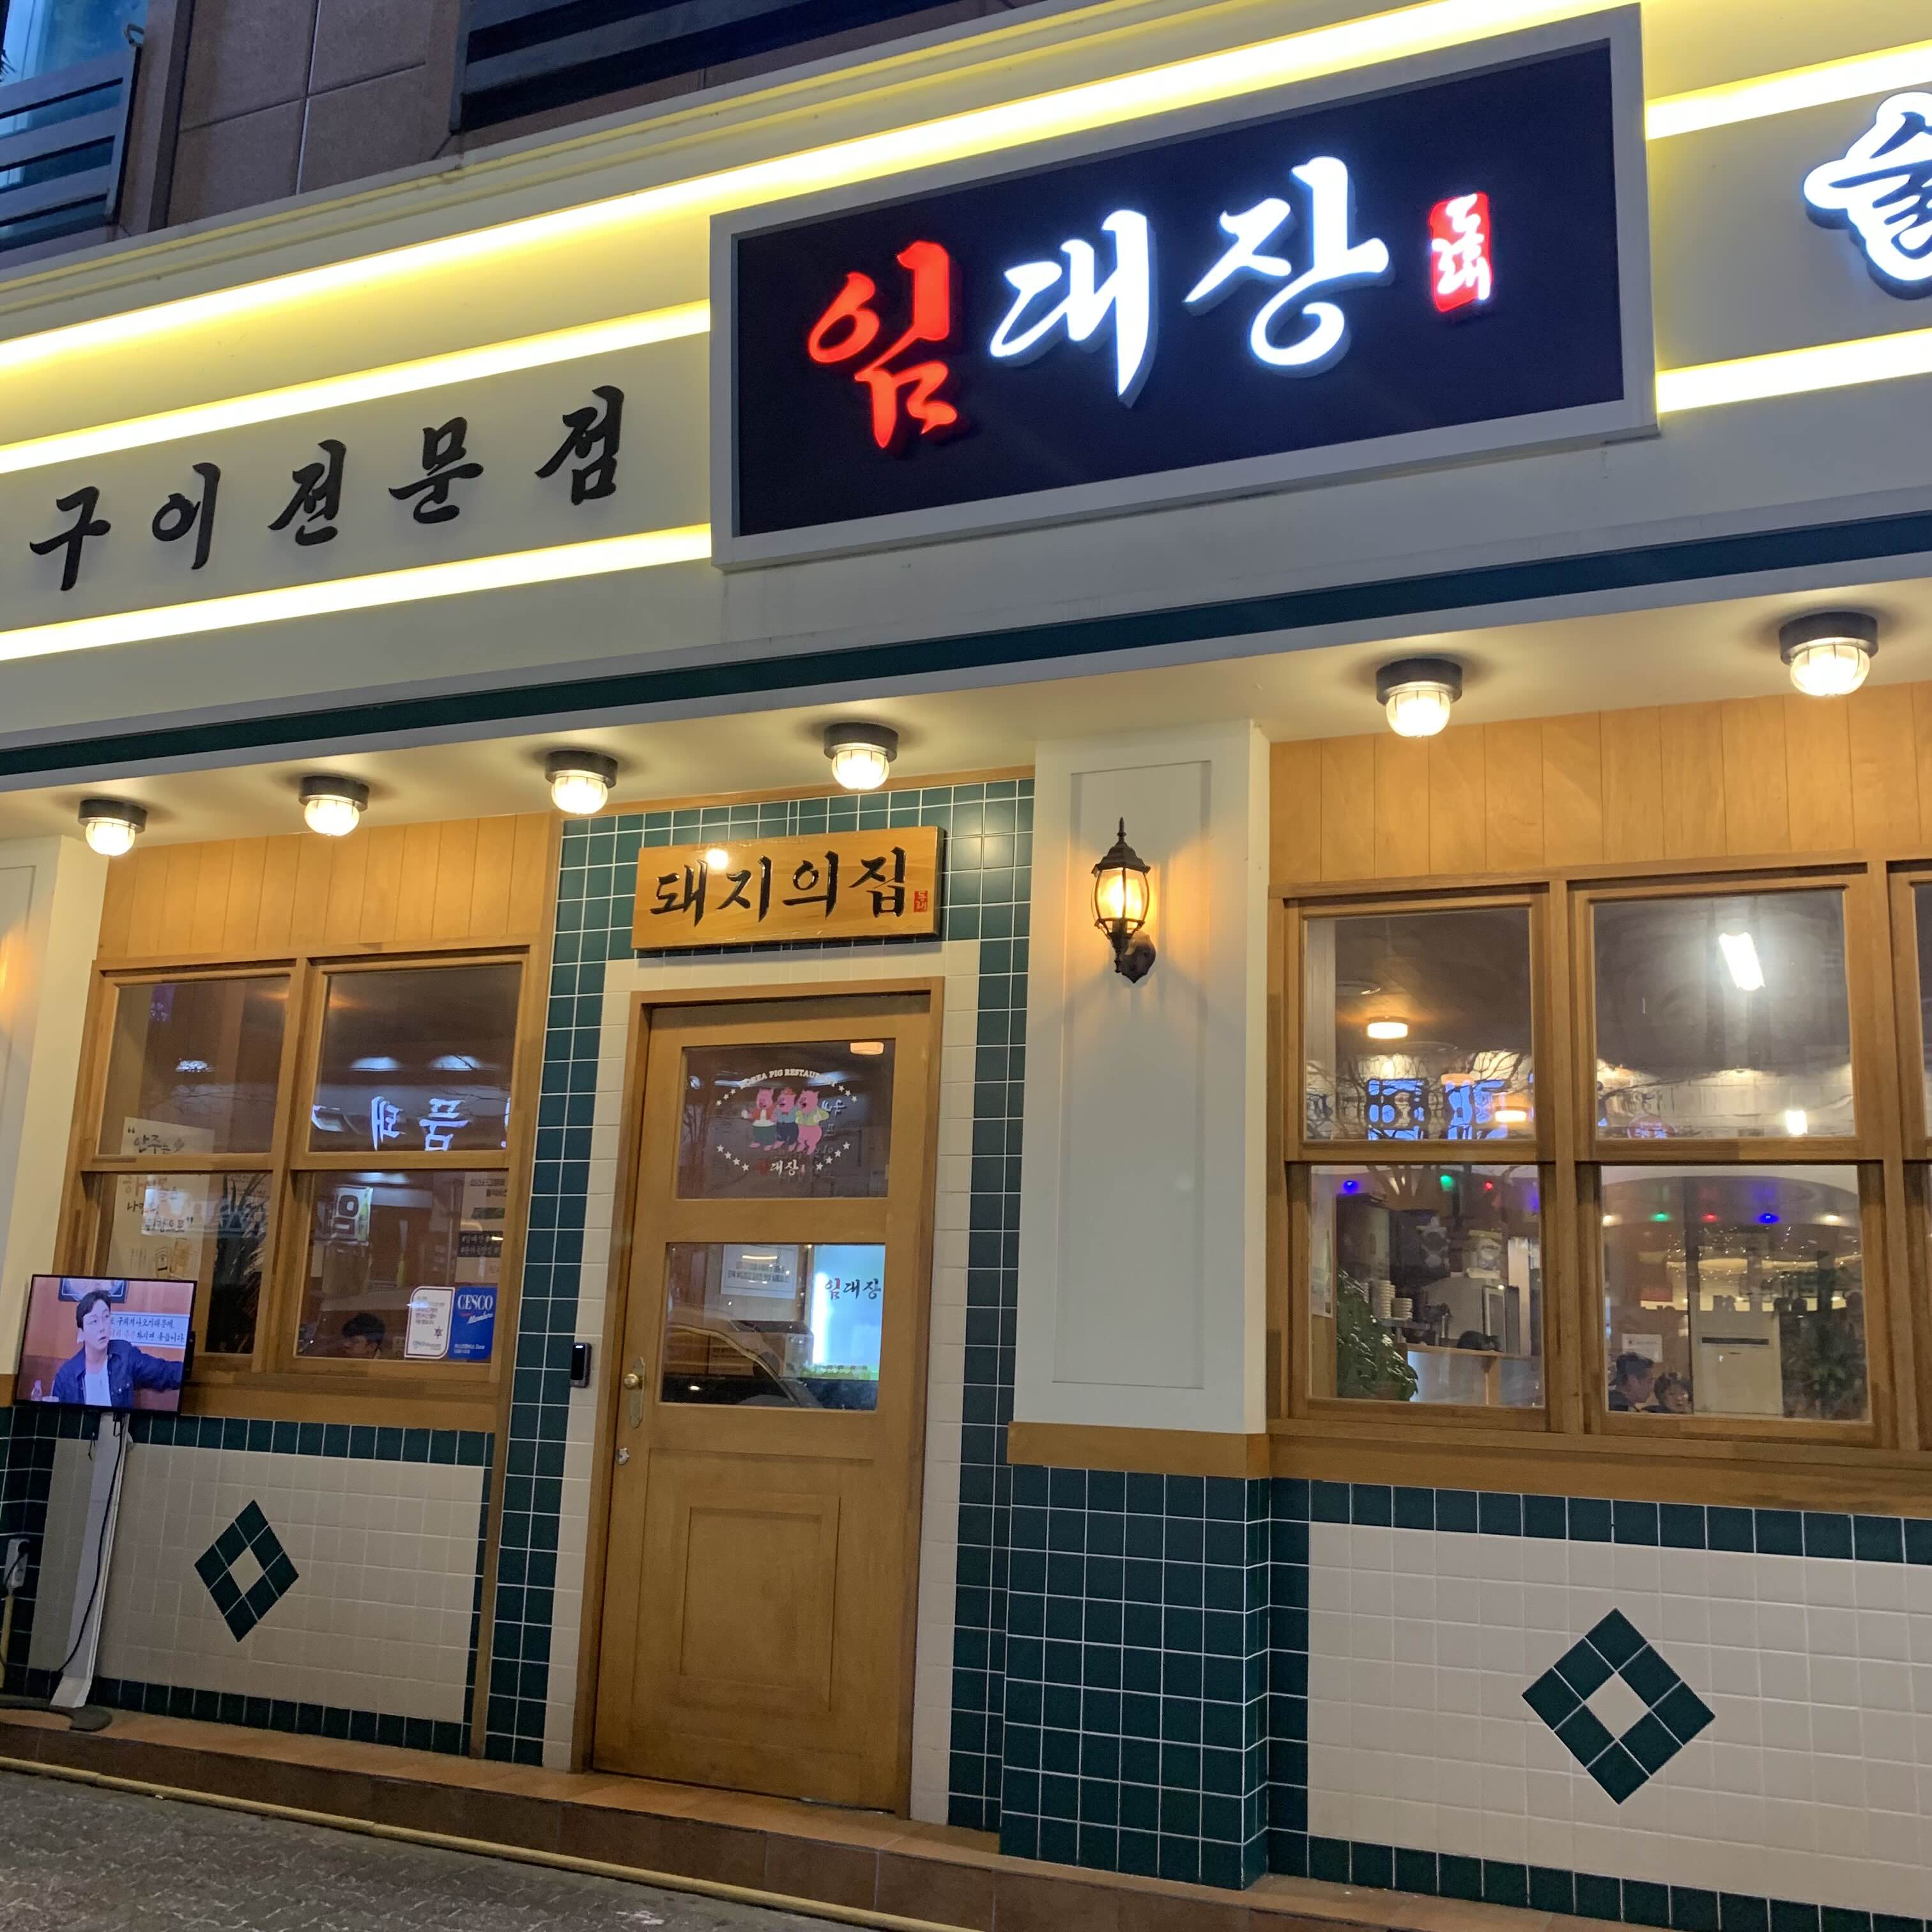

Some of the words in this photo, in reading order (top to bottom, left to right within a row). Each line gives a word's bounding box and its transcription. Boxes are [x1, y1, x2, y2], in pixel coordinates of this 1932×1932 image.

[808, 156, 1389, 448] 임대장
[769, 1069, 783, 1078] PIG
[825, 1277, 882, 1300] 임대장
[457, 1294, 493, 1310] CESCO
